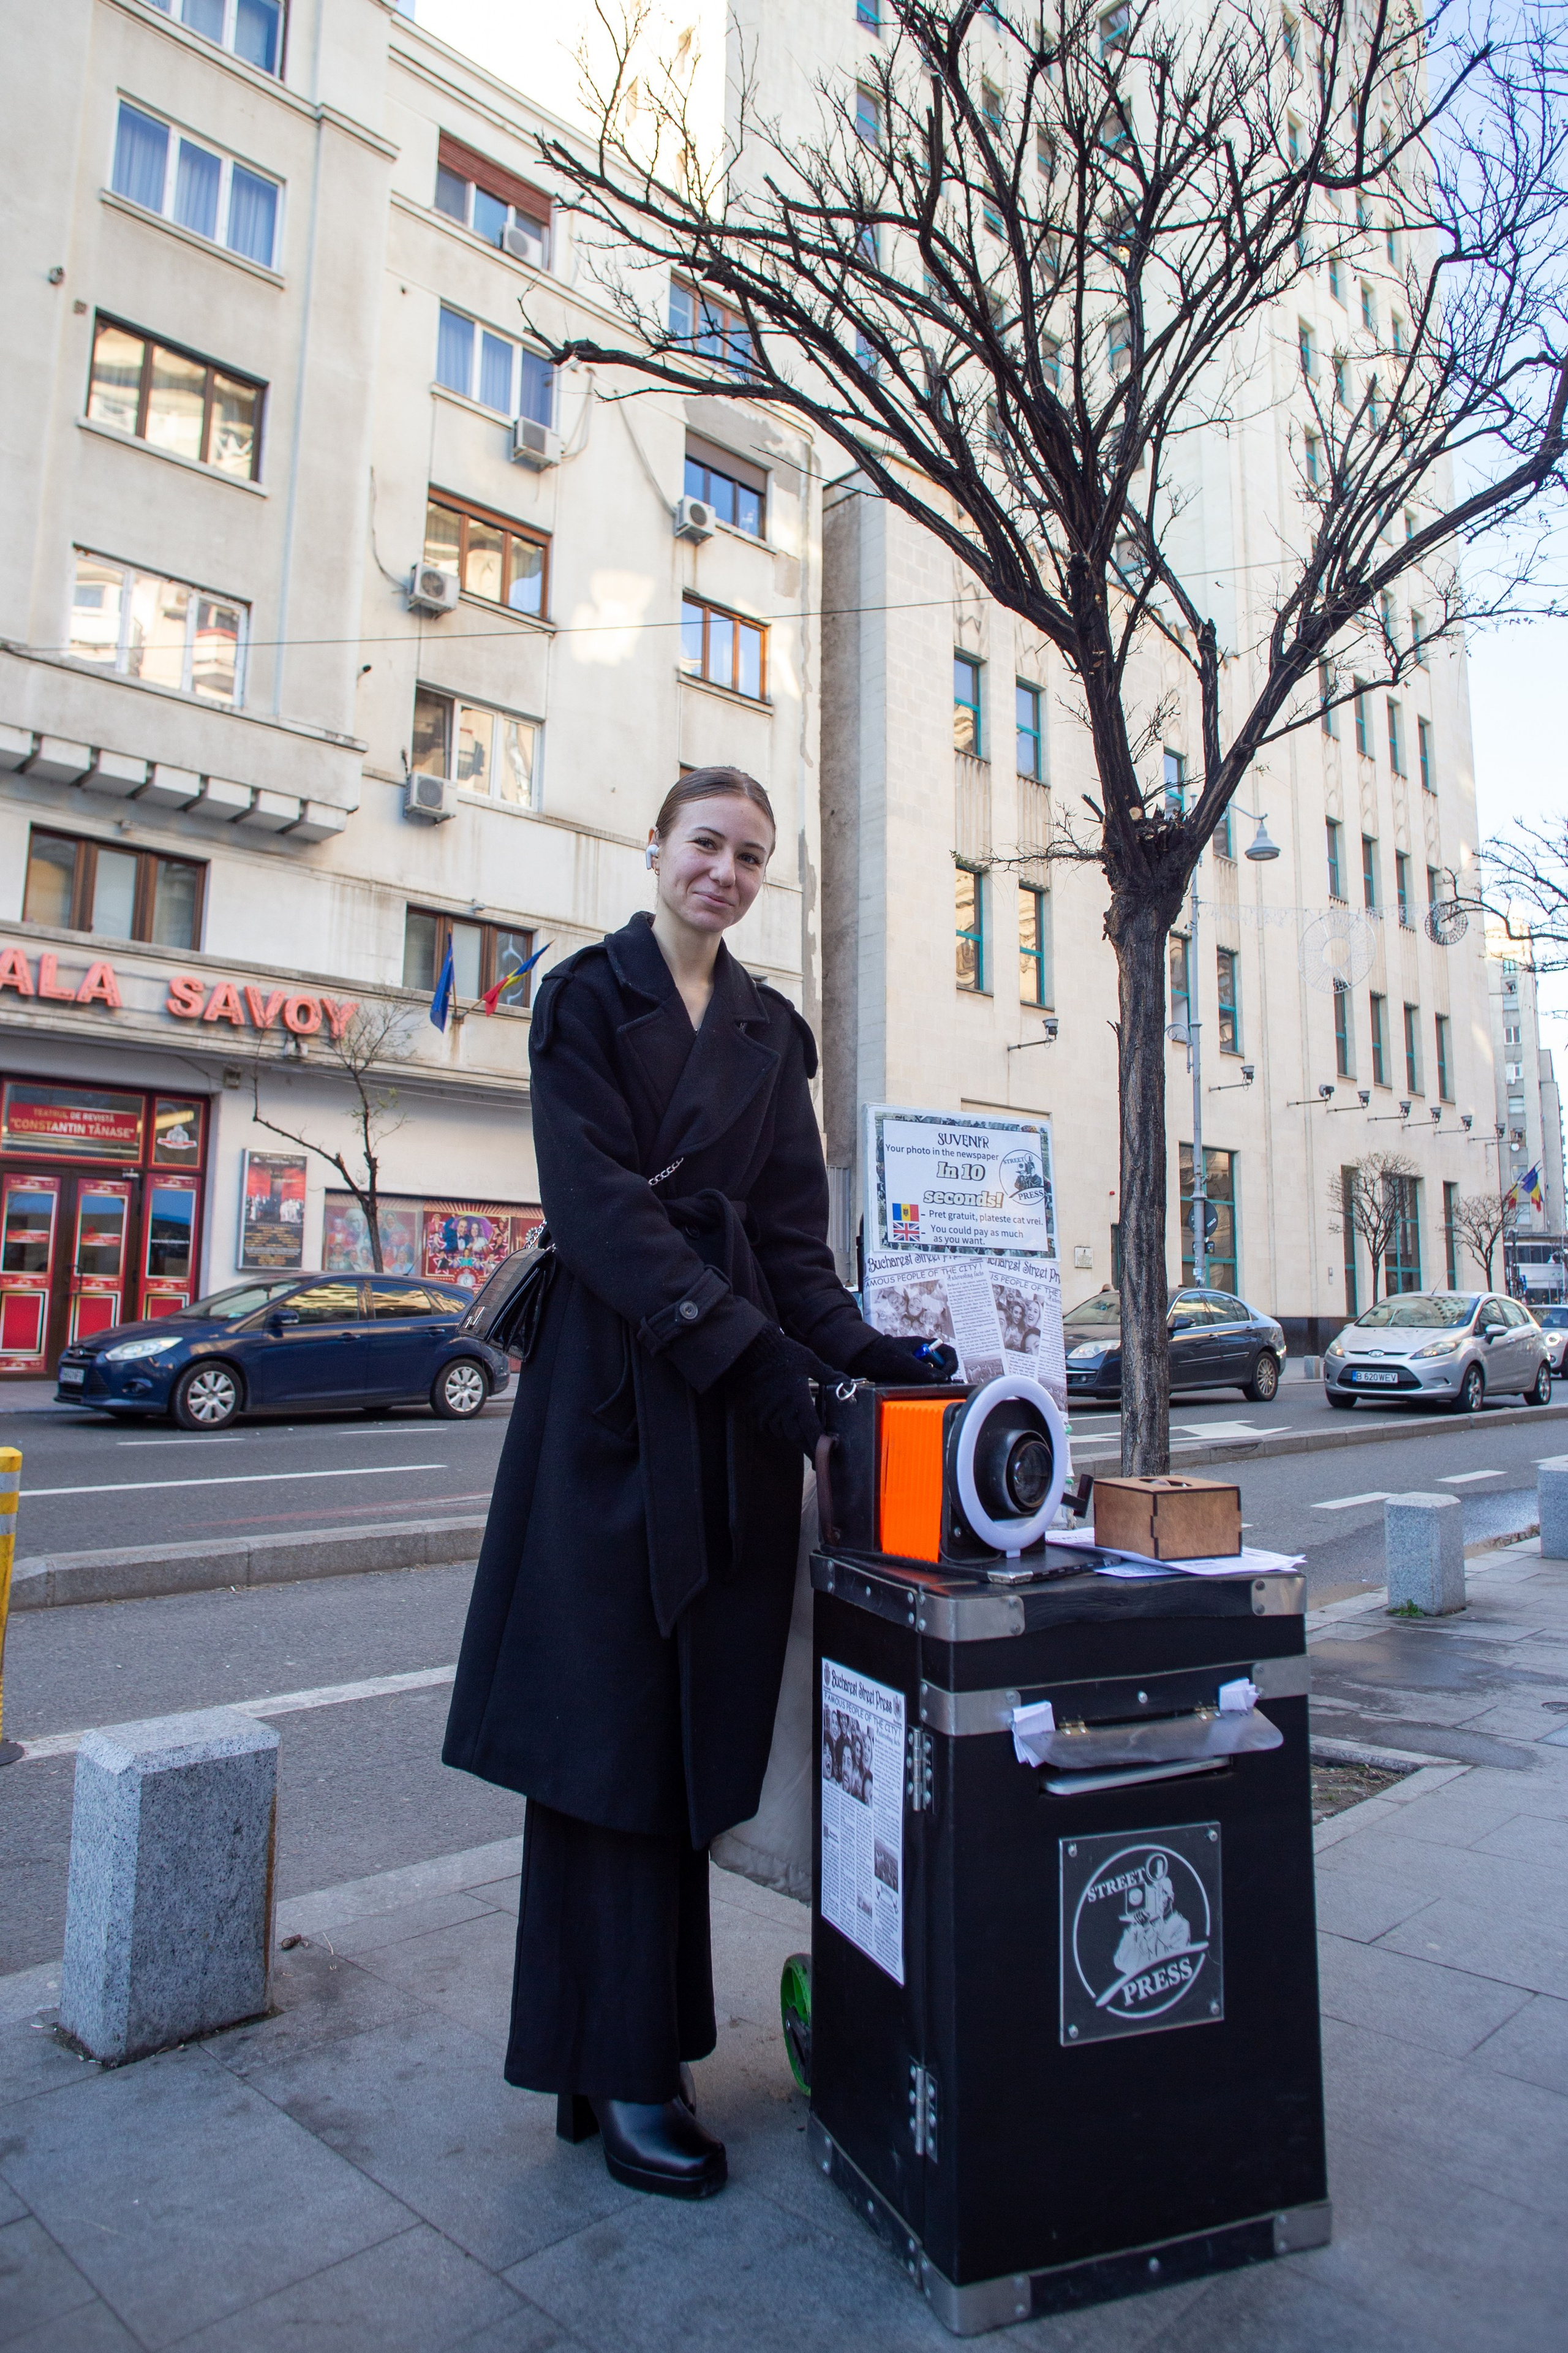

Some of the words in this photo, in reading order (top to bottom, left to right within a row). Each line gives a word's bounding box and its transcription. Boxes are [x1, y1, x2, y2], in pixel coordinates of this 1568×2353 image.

[0, 948, 123, 1007] ALA
[165, 976, 360, 1039] SAVOY
[70, 1111, 81, 1120] DE
[938, 1133, 989, 1149] SUVENIR
[886, 1144, 904, 1153] Your
[907, 1146, 930, 1155] photo
[932, 1147, 940, 1155] in
[942, 1148, 954, 1157] the
[957, 1151, 998, 1161] newspaper
[937, 1161, 959, 1179] In
[961, 1164, 985, 1181] 10
[923, 1190, 1004, 1208] seconds!
[1018, 1190, 1044, 1200] PRESS
[929, 1210, 946, 1218] Pret
[949, 1211, 978, 1222] gratuit,
[980, 1213, 1011, 1223] plateste
[931, 1225, 946, 1233] You
[949, 1225, 971, 1235] could
[974, 1228, 988, 1237] pay
[1001, 1229, 1023, 1238] much
[944, 1236, 960, 1245] you
[962, 1236, 986, 1245] want.
[868, 1254, 913, 1273] Bucharest
[897, 1272, 926, 1282] PEOPLE
[927, 1269, 939, 1277] OF
[941, 1266, 956, 1275] THE
[959, 1263, 977, 1272] CITY
[1023, 1261, 1047, 1279] Street
[1001, 1275, 1028, 1289] PEOPLE
[1044, 1287, 1058, 1297] THE
[832, 1669, 858, 1697] Bucharest
[858, 1681, 874, 1706] Street
[875, 1690, 892, 1714] Press
[824, 1691, 845, 1709] FAMOUS
[846, 1702, 864, 1719] PEOPLE
[864, 1713, 872, 1722] OF
[873, 1717, 883, 1730] THE
[884, 1723, 898, 1735] CITY
[1086, 1867, 1146, 1903] STREET
[1121, 1957, 1193, 2007] PRESS
